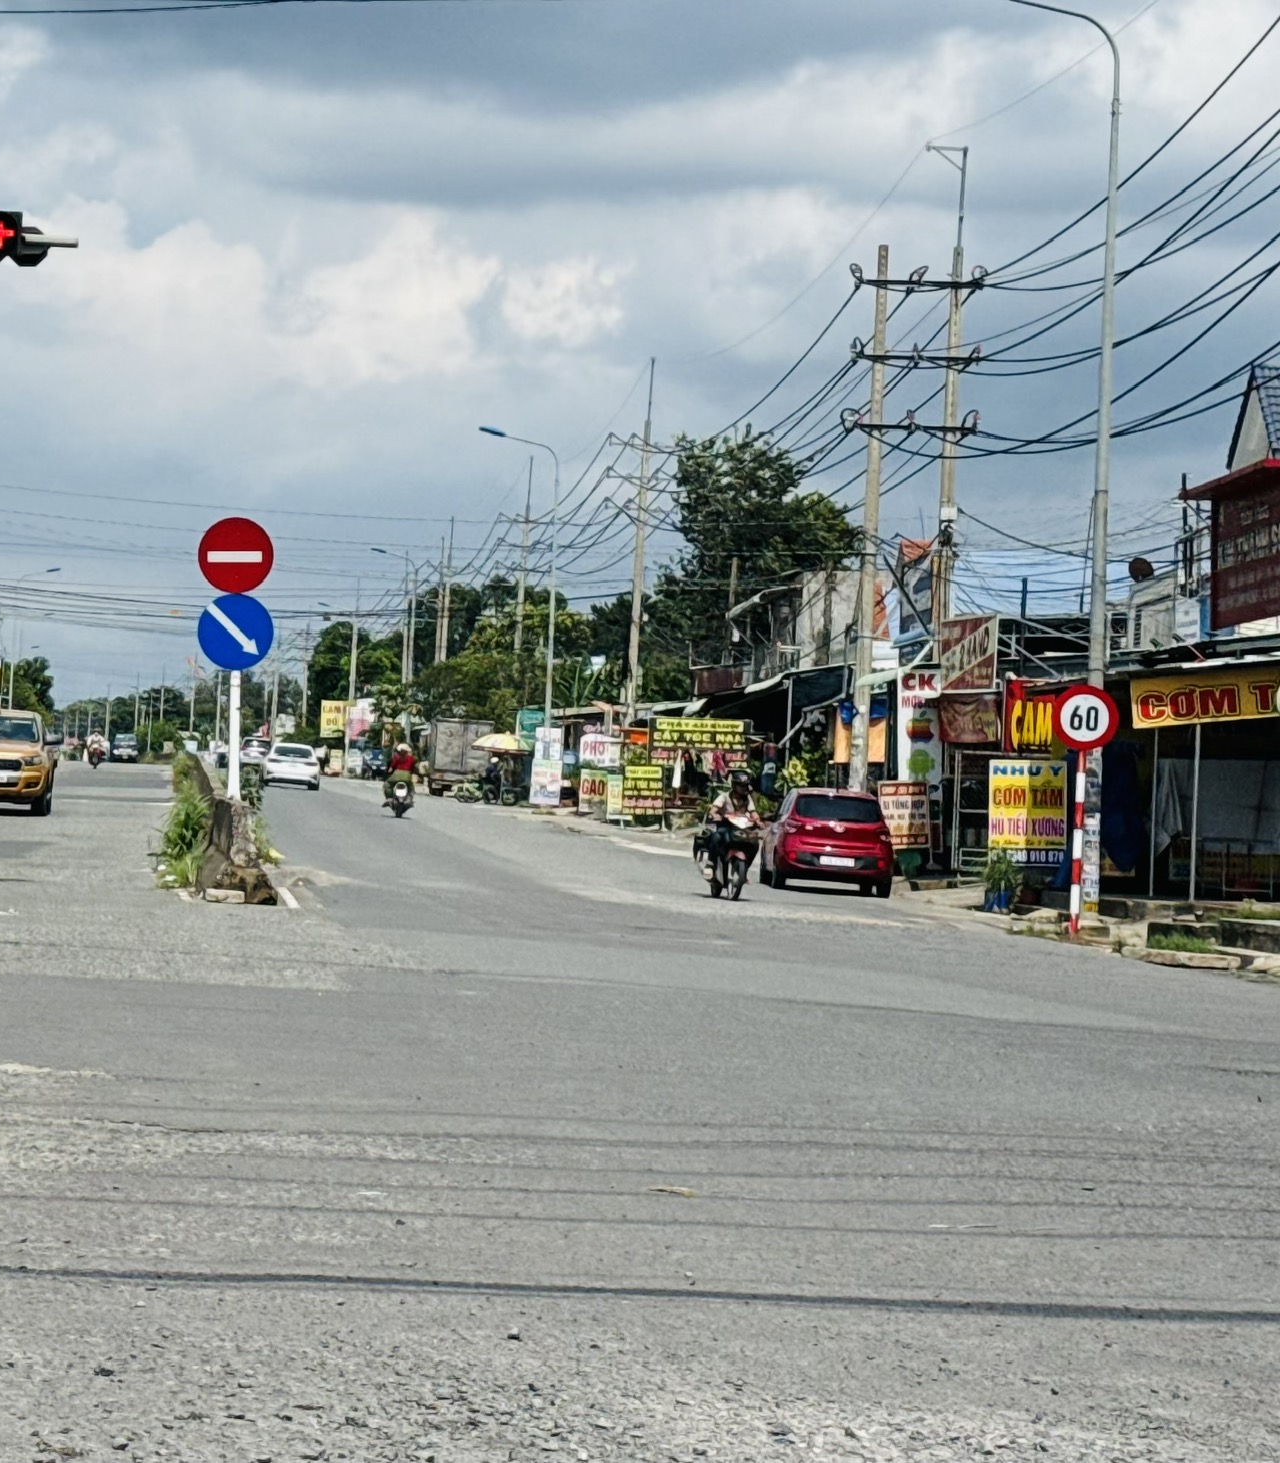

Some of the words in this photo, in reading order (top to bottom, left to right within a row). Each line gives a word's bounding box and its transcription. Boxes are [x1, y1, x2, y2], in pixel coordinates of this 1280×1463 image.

[901, 673, 937, 691] CK
[1137, 684, 1240, 723] CƠM
[1070, 705, 1099, 731] 60
[992, 784, 1026, 807] CƠM
